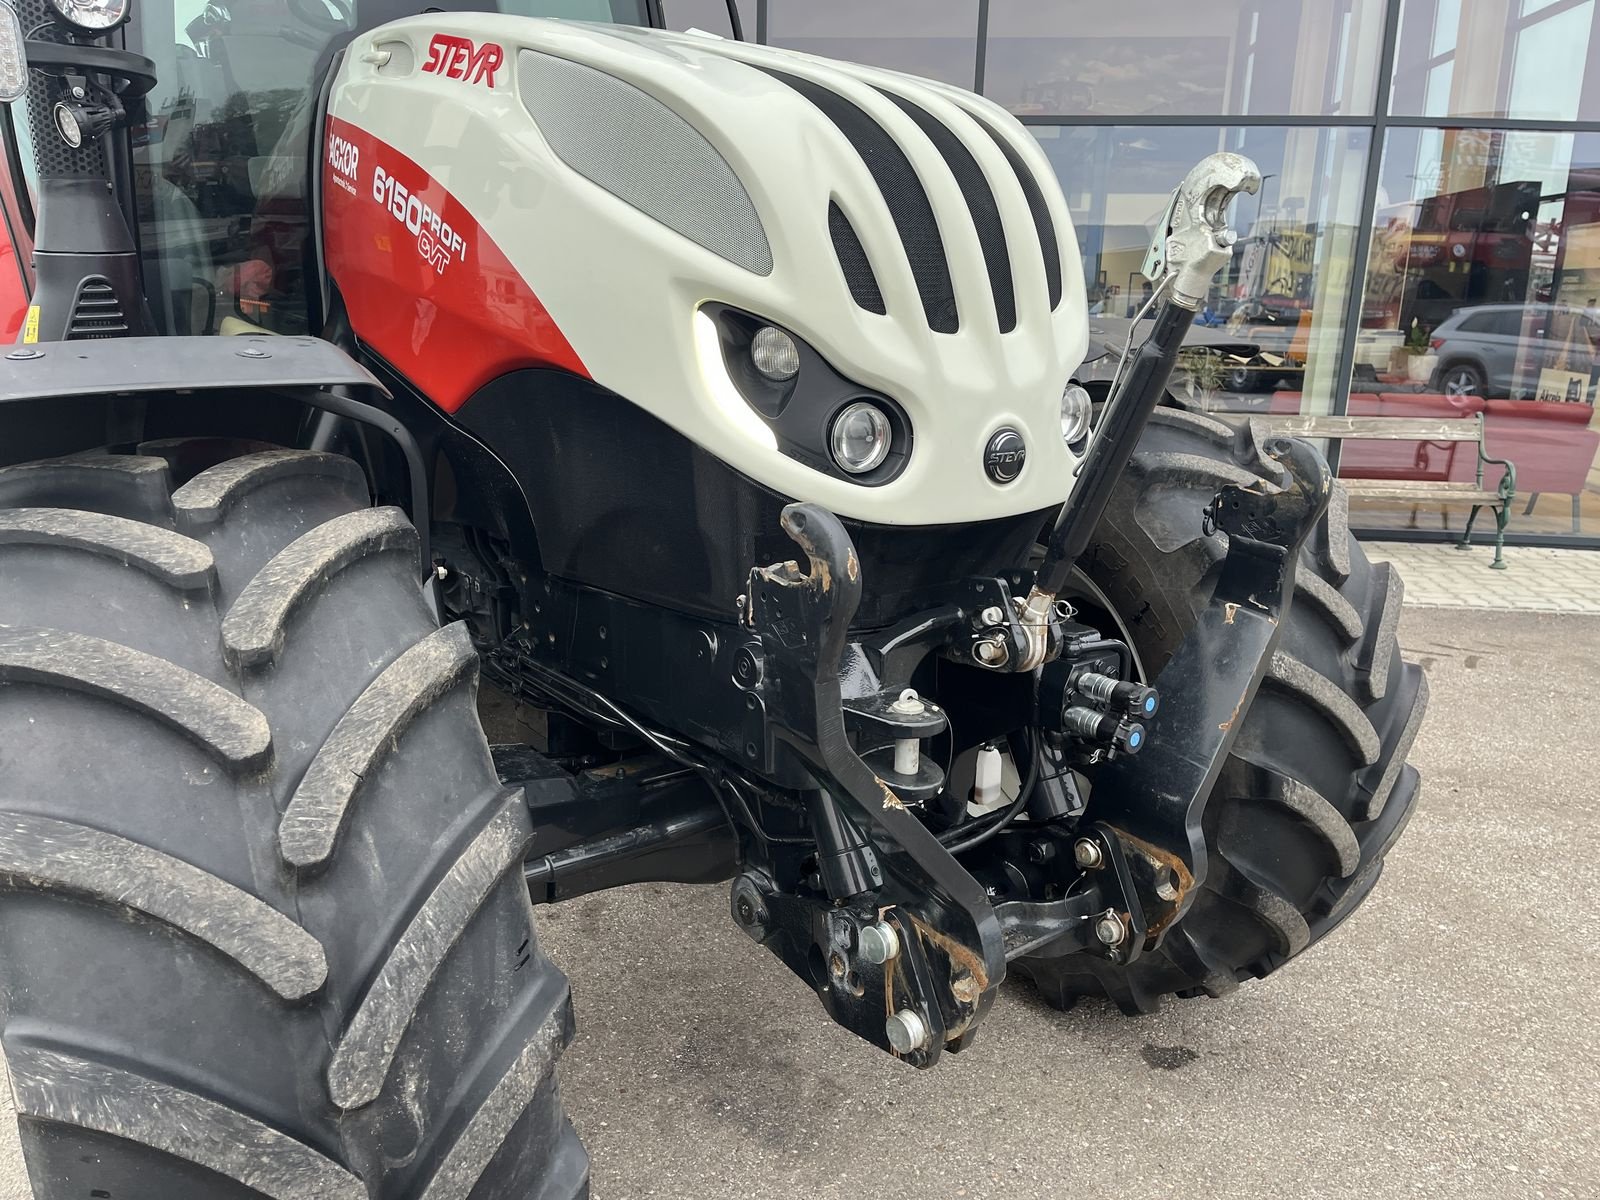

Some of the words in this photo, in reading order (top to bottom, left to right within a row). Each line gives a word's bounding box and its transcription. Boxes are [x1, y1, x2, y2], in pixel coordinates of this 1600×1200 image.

[421, 33, 504, 88] STEYR
[329, 134, 359, 181] AGXOR
[373, 166, 422, 237] 6150
[422, 204, 467, 262] PROFI
[418, 229, 451, 275] CVT
[988, 449, 1026, 464] STEYR
